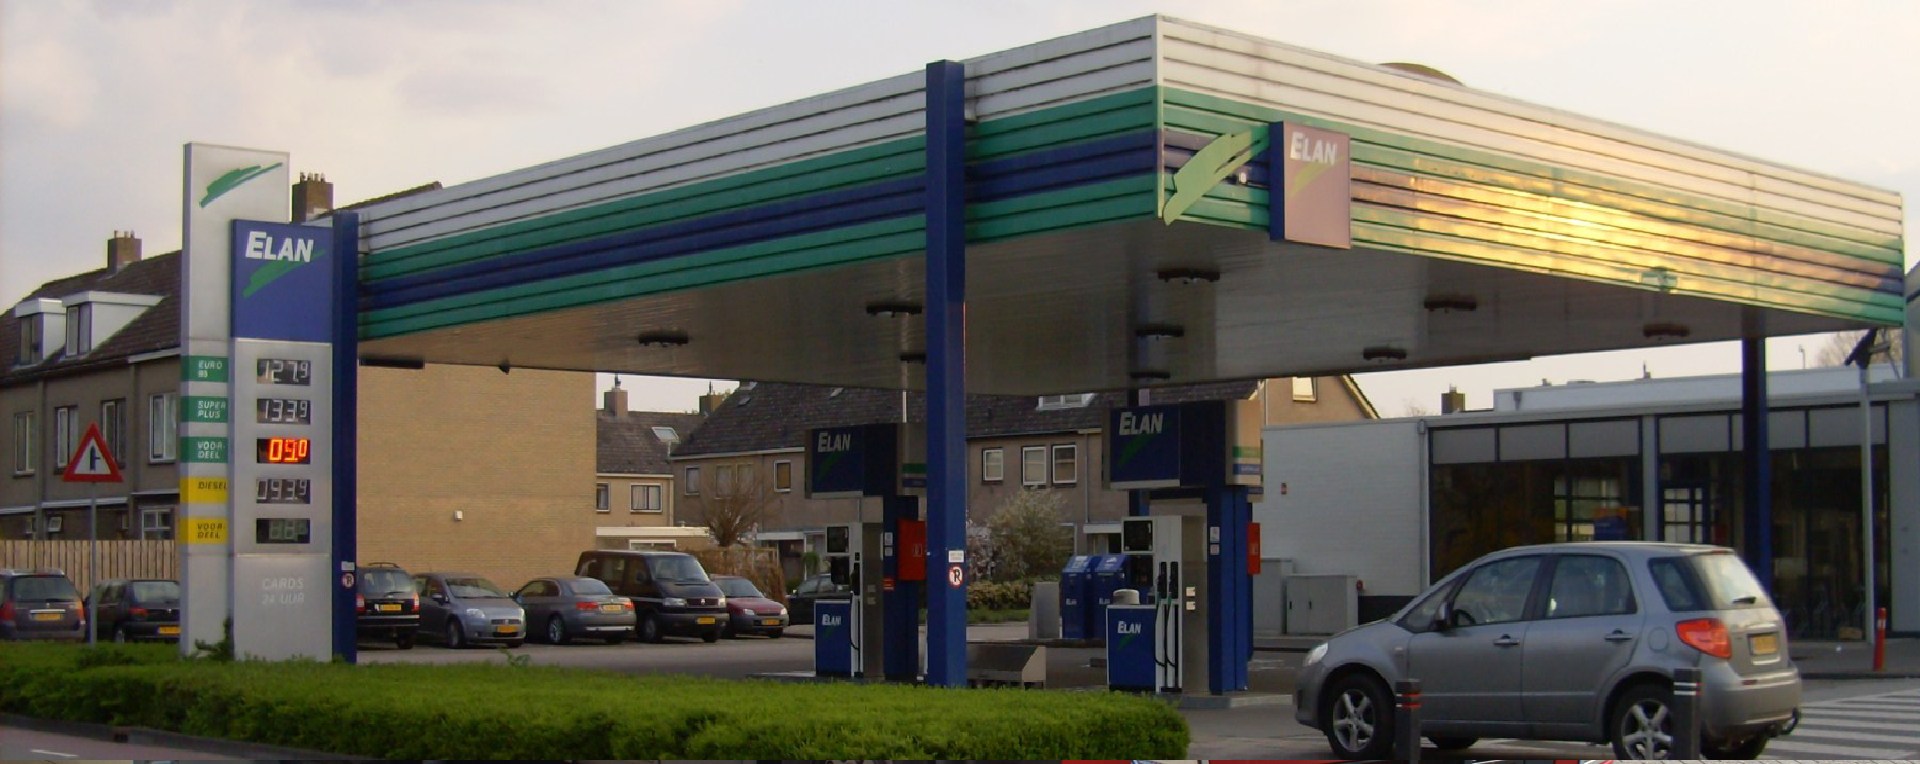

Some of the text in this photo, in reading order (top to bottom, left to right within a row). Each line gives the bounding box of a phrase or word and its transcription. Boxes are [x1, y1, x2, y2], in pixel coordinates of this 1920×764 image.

[1290, 131, 1338, 166] ELAN
[245, 231, 314, 262] ELAN
[198, 359, 222, 370] EURO
[197, 400, 226, 410] SUPER
[197, 409, 220, 419] PLUS
[1119, 412, 1163, 436] ELAN
[817, 432, 851, 453] ELAN
[197, 450, 220, 459] DEEL
[198, 481, 227, 491] DIESEL
[197, 531, 220, 540] DEEL
[262, 578, 304, 590] CARDS
[281, 592, 304, 604] UUR
[822, 614, 842, 626] ELAN
[1117, 621, 1141, 634] ELAN
